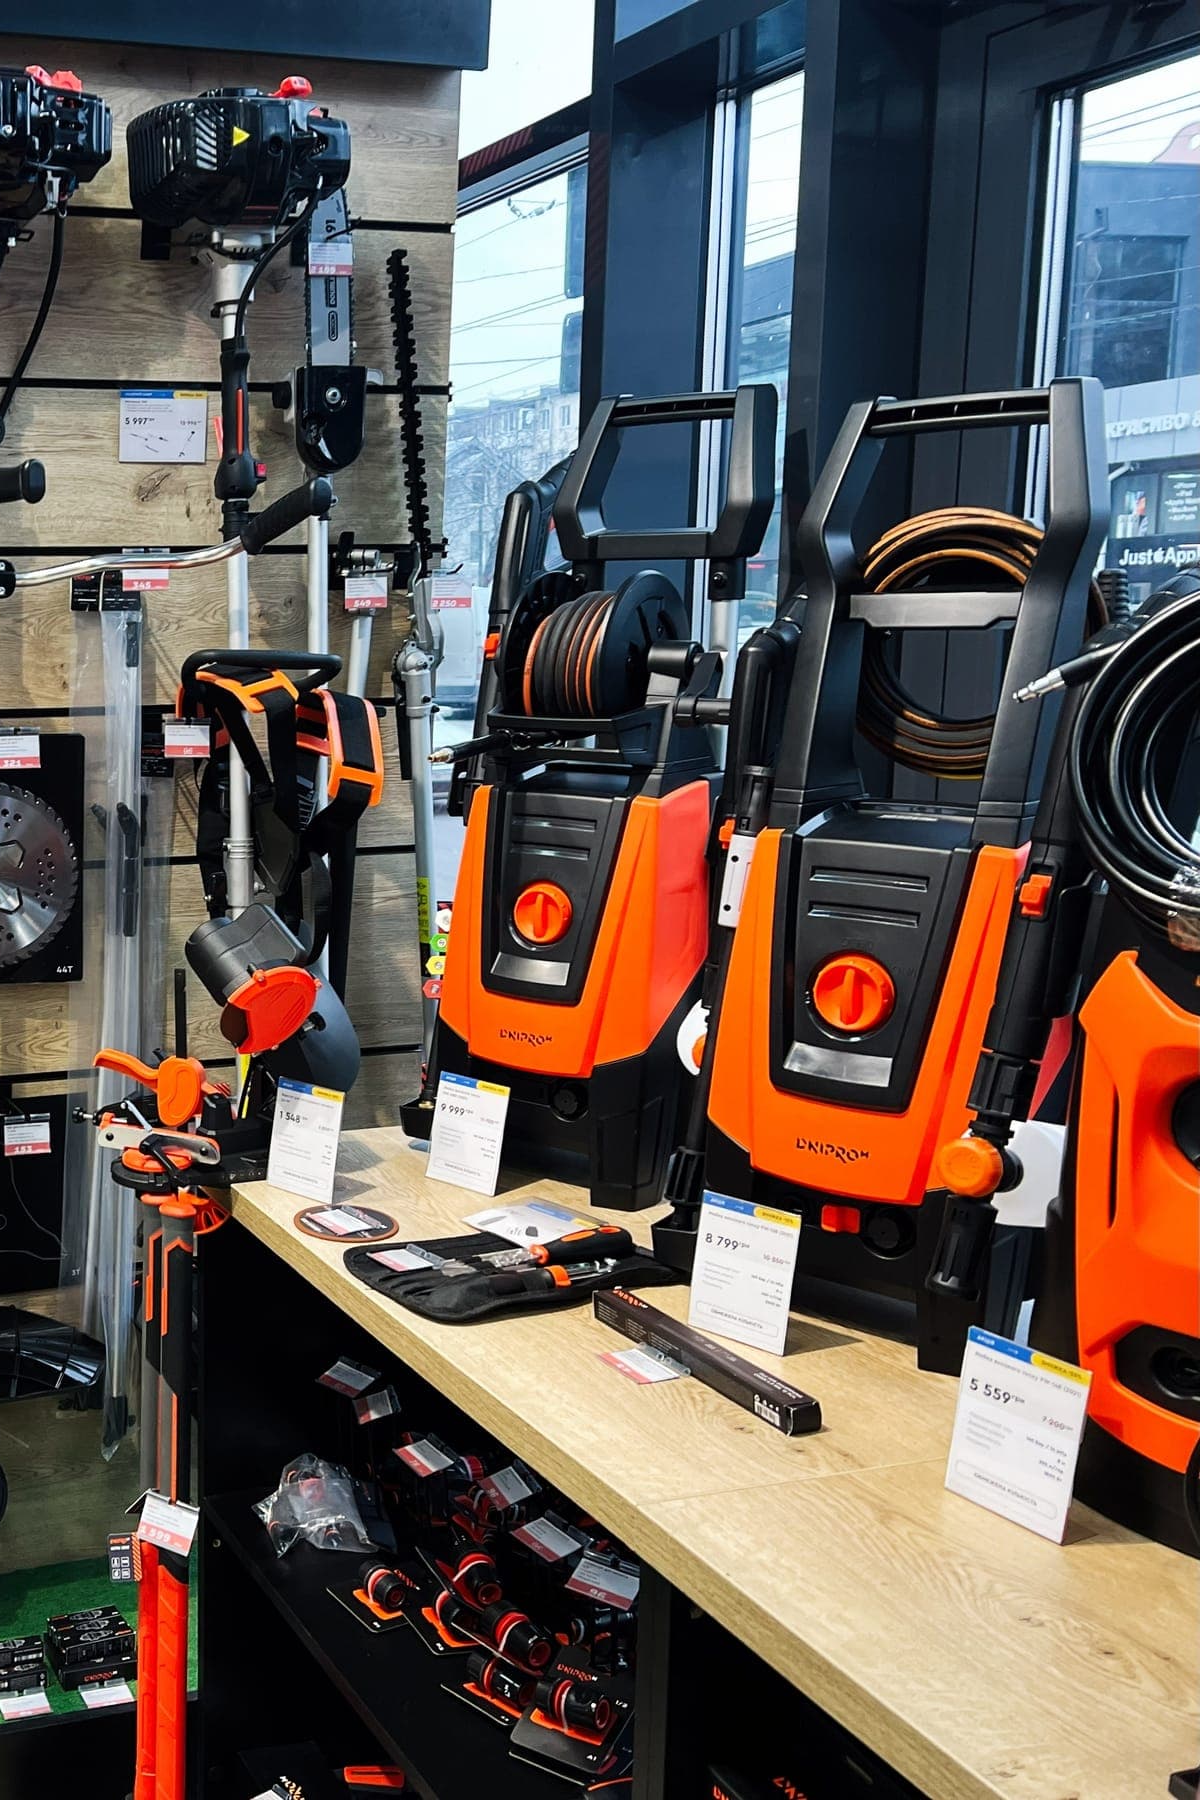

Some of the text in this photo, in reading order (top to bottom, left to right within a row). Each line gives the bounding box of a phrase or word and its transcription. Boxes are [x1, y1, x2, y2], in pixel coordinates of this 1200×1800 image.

[125, 417, 148, 425] 5 997
[1119, 550, 1152, 567] Just
[56, 965, 74, 974] 44T
[441, 1103, 447, 1112] 9
[449, 1105, 465, 1117] 999
[285, 1112, 301, 1124] 548
[796, 1137, 870, 1164] DNIPROM
[705, 1233, 712, 1244] 8
[717, 1236, 738, 1251] 799
[970, 1378, 979, 1392] 5
[983, 1384, 1011, 1404] 559
